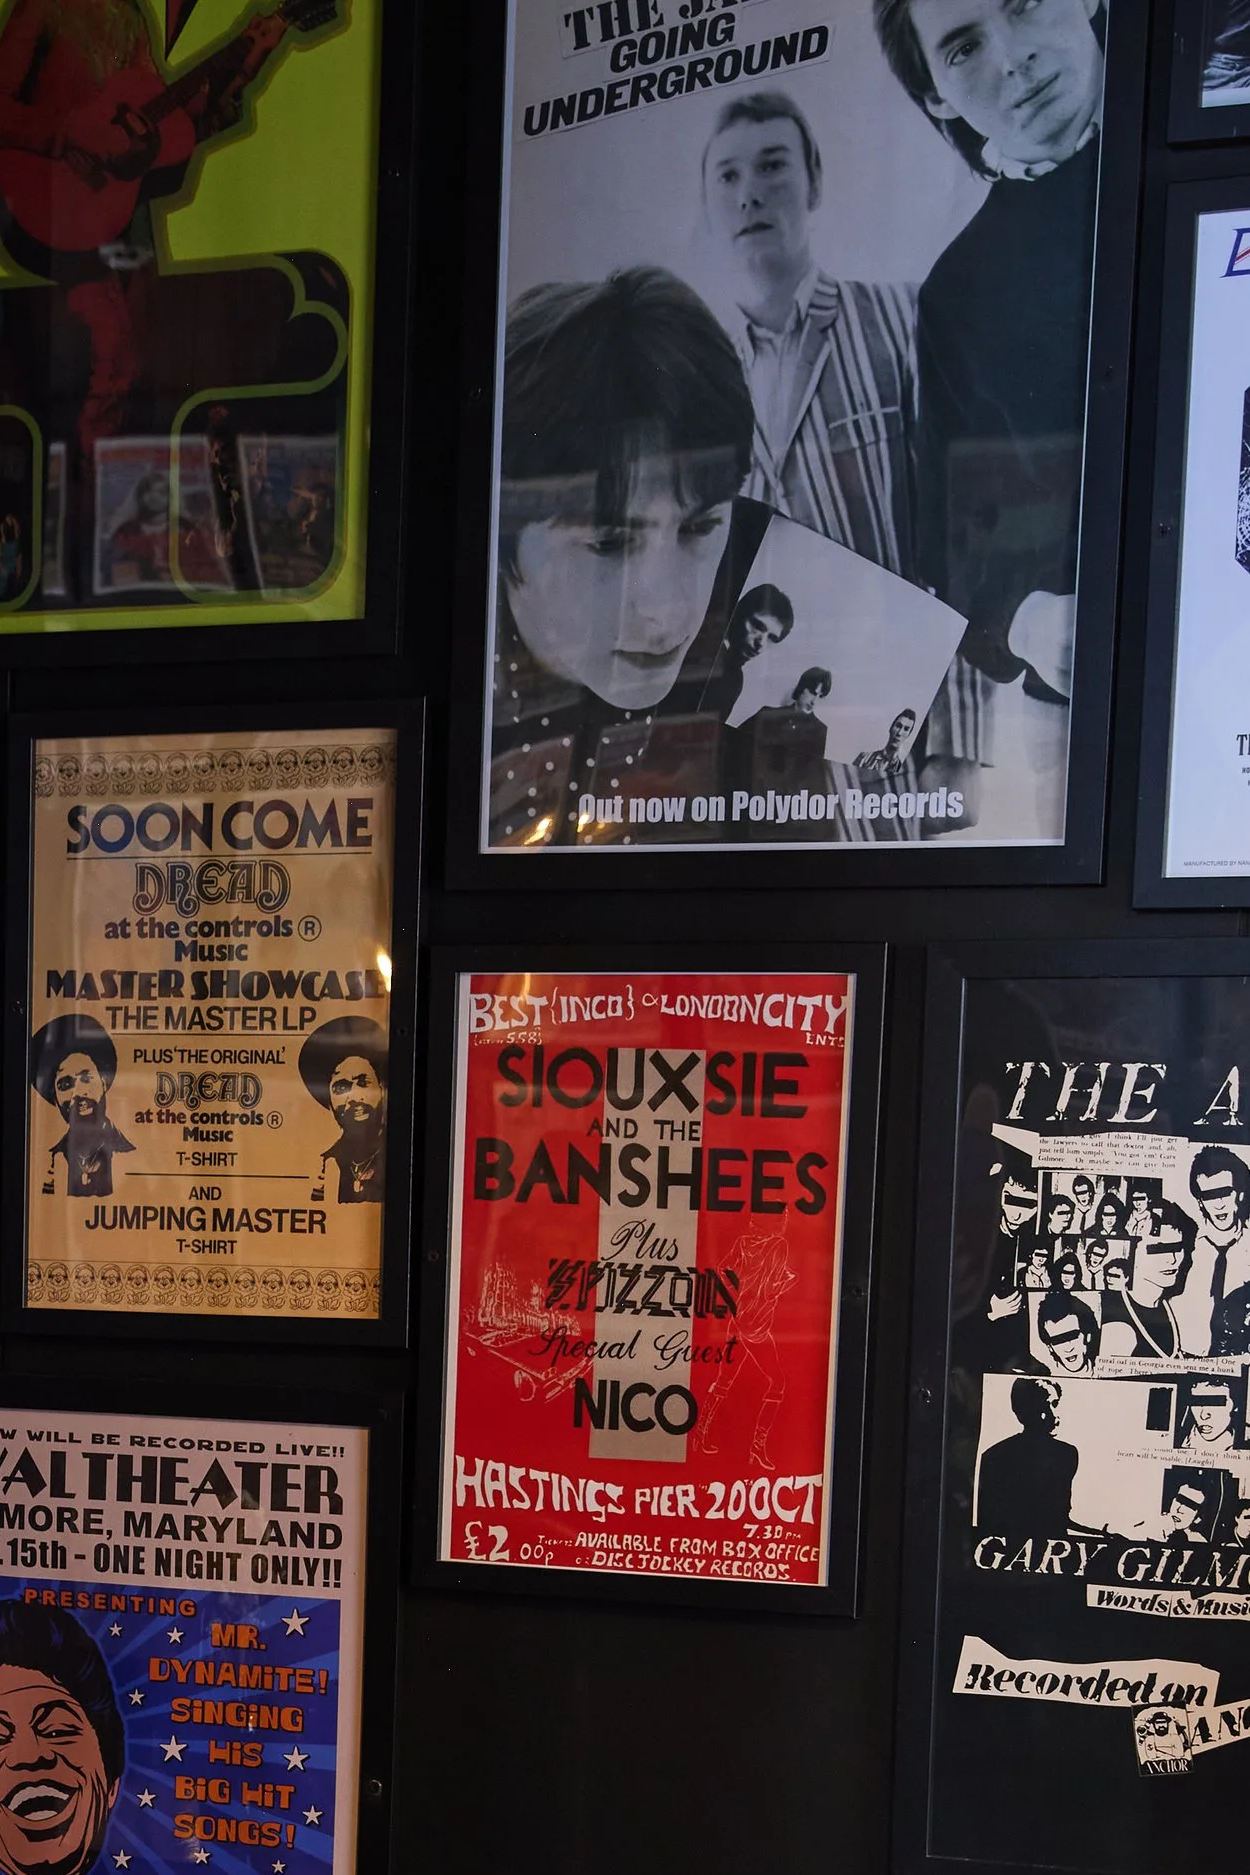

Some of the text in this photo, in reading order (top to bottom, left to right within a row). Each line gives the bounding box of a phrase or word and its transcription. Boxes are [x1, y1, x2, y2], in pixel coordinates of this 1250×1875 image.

[564, 0, 665, 50] THE
[610, 12, 736, 73] GOING
[523, 25, 829, 137] UNDERGROUND
[578, 786, 964, 825] Out now on Polydor Records
[67, 797, 374, 855] SOON COME
[132, 859, 291, 917] DREAD
[104, 914, 293, 941] at the controls
[174, 939, 248, 964] Music
[47, 968, 387, 1002] MASTER SHOWCASE
[105, 1005, 316, 1033] THE MASTER LP
[469, 991, 550, 1034] BEST
[761, 992, 848, 1034] CITY
[133, 1048, 174, 1065] PLUS
[154, 1071, 263, 1111] DREAD
[497, 1044, 811, 1120] SIOUXSIE
[1004, 1061, 1245, 1126] THE A
[134, 1109, 264, 1128] at the controls
[182, 1124, 234, 1144] Music
[587, 1117, 702, 1142] AND THE
[176, 1151, 238, 1167] T-SHIRT
[473, 1137, 829, 1216] BANSHEES
[188, 1186, 222, 1201] AND
[85, 1203, 327, 1236] JUMPING MASTER
[175, 1238, 238, 1257] T-SHIRT
[600, 1219, 680, 1262] Plus
[528, 1326, 741, 1371] Special Guest
[572, 1378, 699, 1436] NICO
[27, 1429, 82, 1444] WILL
[91, 1433, 121, 1446] BE
[129, 1434, 266, 1455] RECORDED
[275, 1443, 346, 1458] LIVE!!
[82, 1452, 344, 1516] THEATER
[455, 1454, 626, 1523] HASTINGS
[634, 1484, 698, 1519] PIER
[123, 1511, 344, 1551] MARYLAND
[575, 1531, 663, 1554] AVAILABLE
[670, 1536, 718, 1556] FROM
[722, 1539, 762, 1559] BOX
[764, 1543, 820, 1564] OFFICE
[7, 1538, 67, 1570] 15th
[93, 1542, 146, 1576] ONE
[154, 1548, 246, 1582] NIGHT
[250, 1553, 343, 1589] ONLY!!
[637, 1551, 706, 1575] JOCKEY
[973, 1535, 1250, 1589] GARY GILM
[23, 1588, 198, 1617] PRESENTING
[1096, 1590, 1192, 1616] Words &
[210, 1622, 268, 1652] MR.
[964, 1662, 1208, 1707] Recorded on
[173, 1812, 296, 1850] SONGS!
